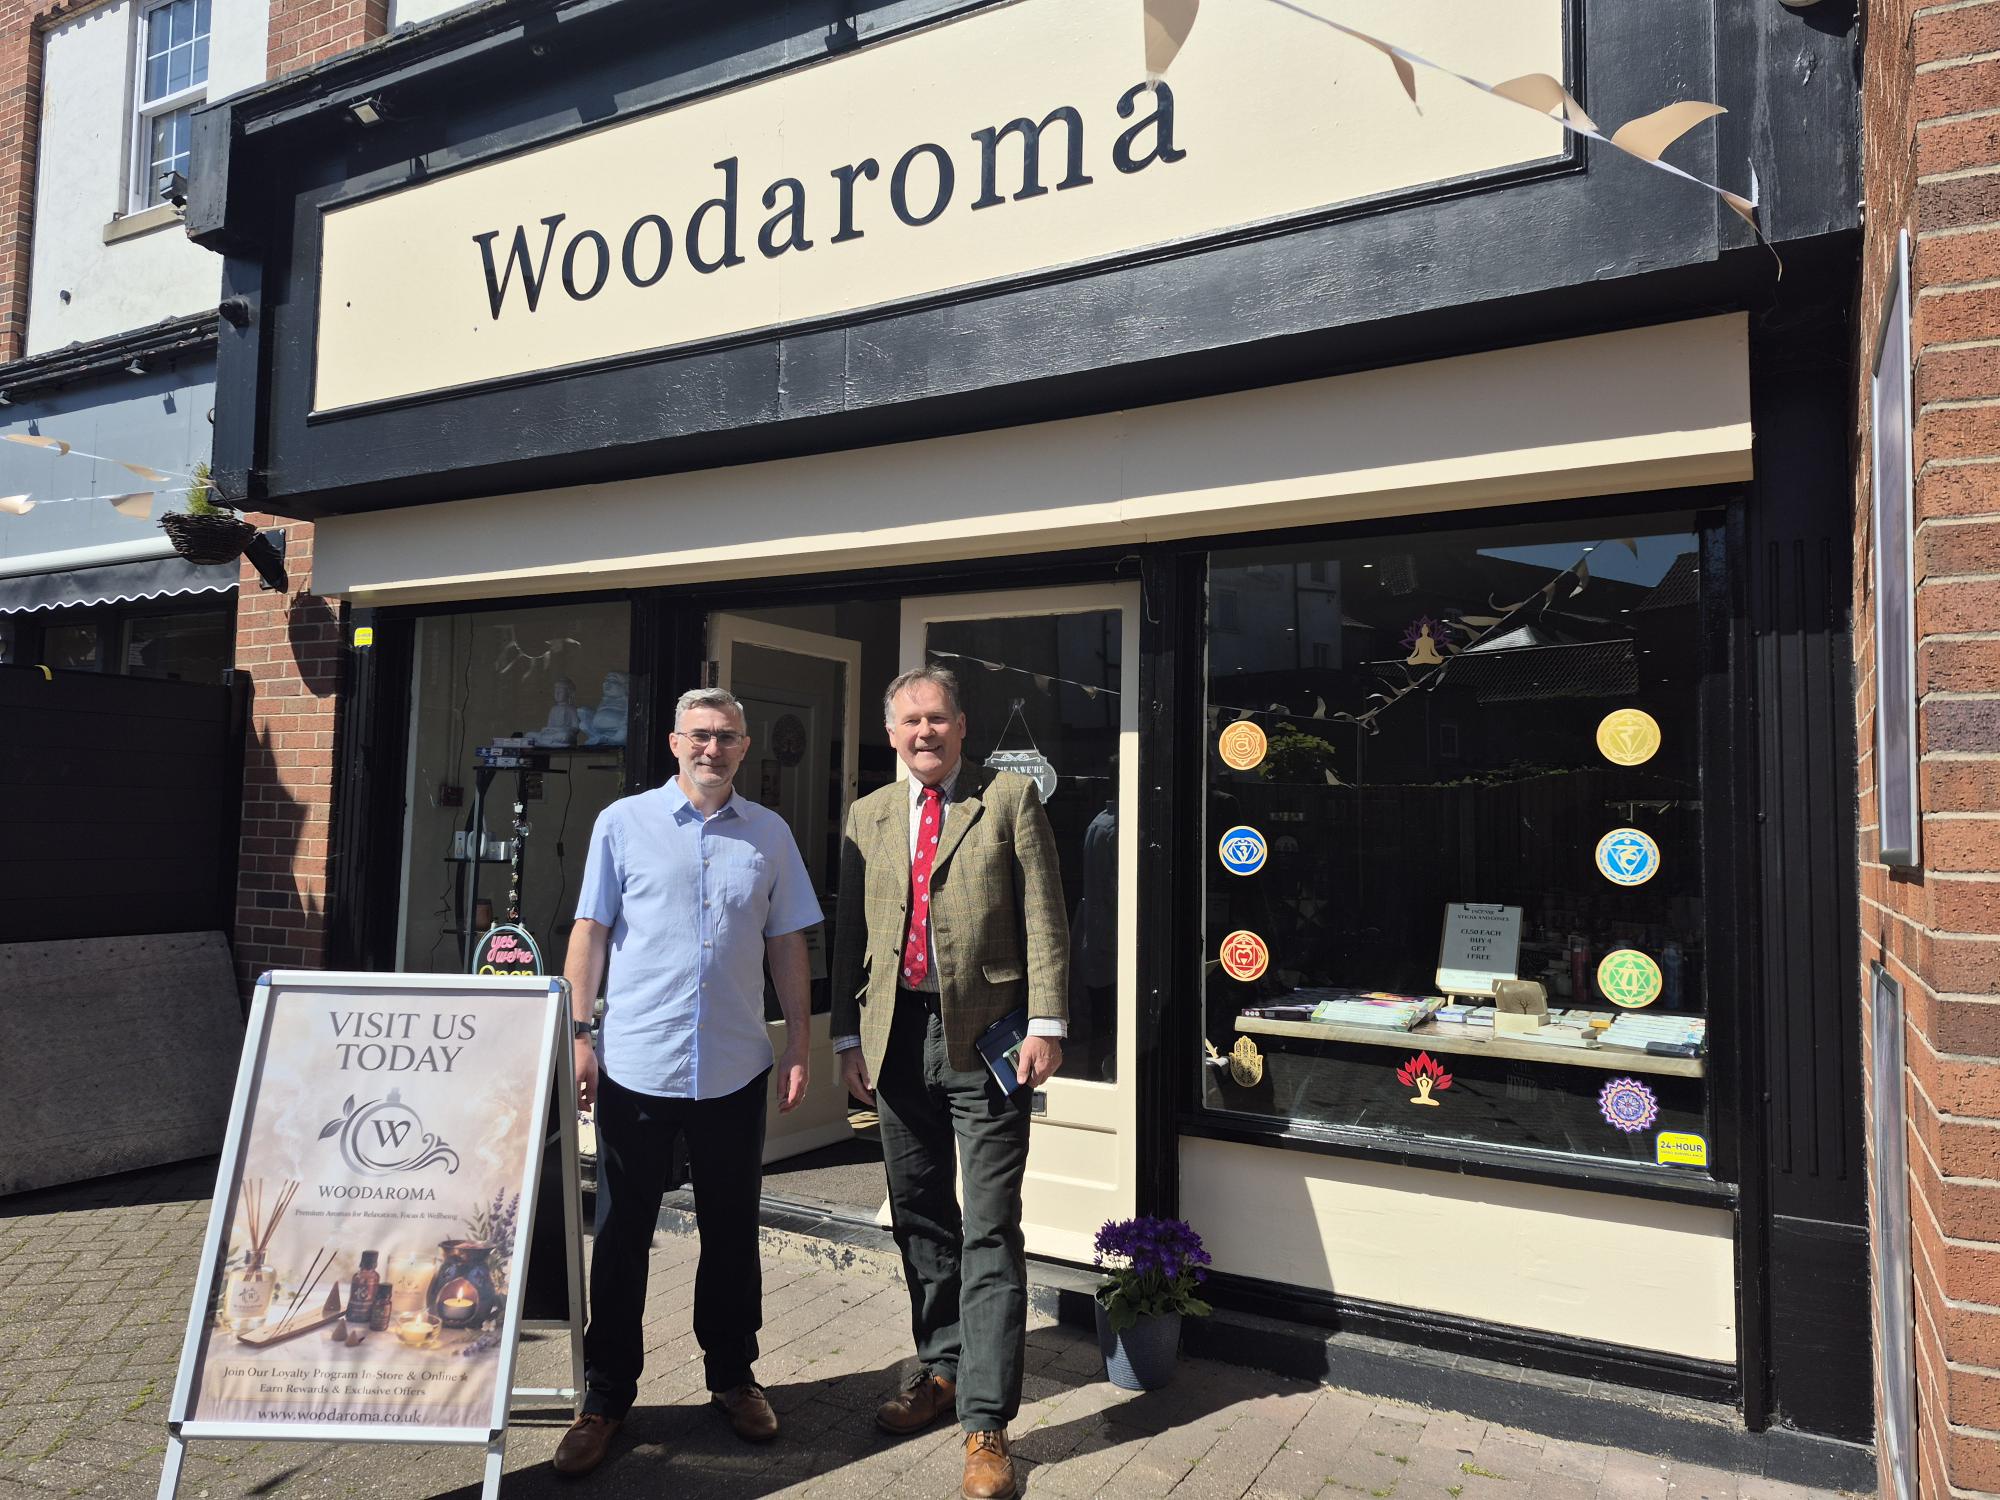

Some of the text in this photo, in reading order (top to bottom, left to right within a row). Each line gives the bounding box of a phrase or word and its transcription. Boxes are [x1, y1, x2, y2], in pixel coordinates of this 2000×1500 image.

[472, 79, 1187, 321] Woodaroma
[329, 1011, 477, 1040] VISIT US
[336, 1043, 464, 1073] TODAY
[371, 1119, 412, 1149] W
[1660, 1140, 1703, 1153] 24-HOUR
[318, 1185, 436, 1201] WOODAROMA
[223, 1367, 245, 1379] Join
[247, 1367, 269, 1377] Our
[271, 1368, 309, 1381] Loyalty
[313, 1368, 358, 1381] Program
[406, 1370, 416, 1381] &
[421, 1370, 457, 1382] Online
[260, 1383, 426, 1396] Earn Rewards & Exclusive Offers
[258, 1408, 422, 1423] www.woodaroma.co.uk
